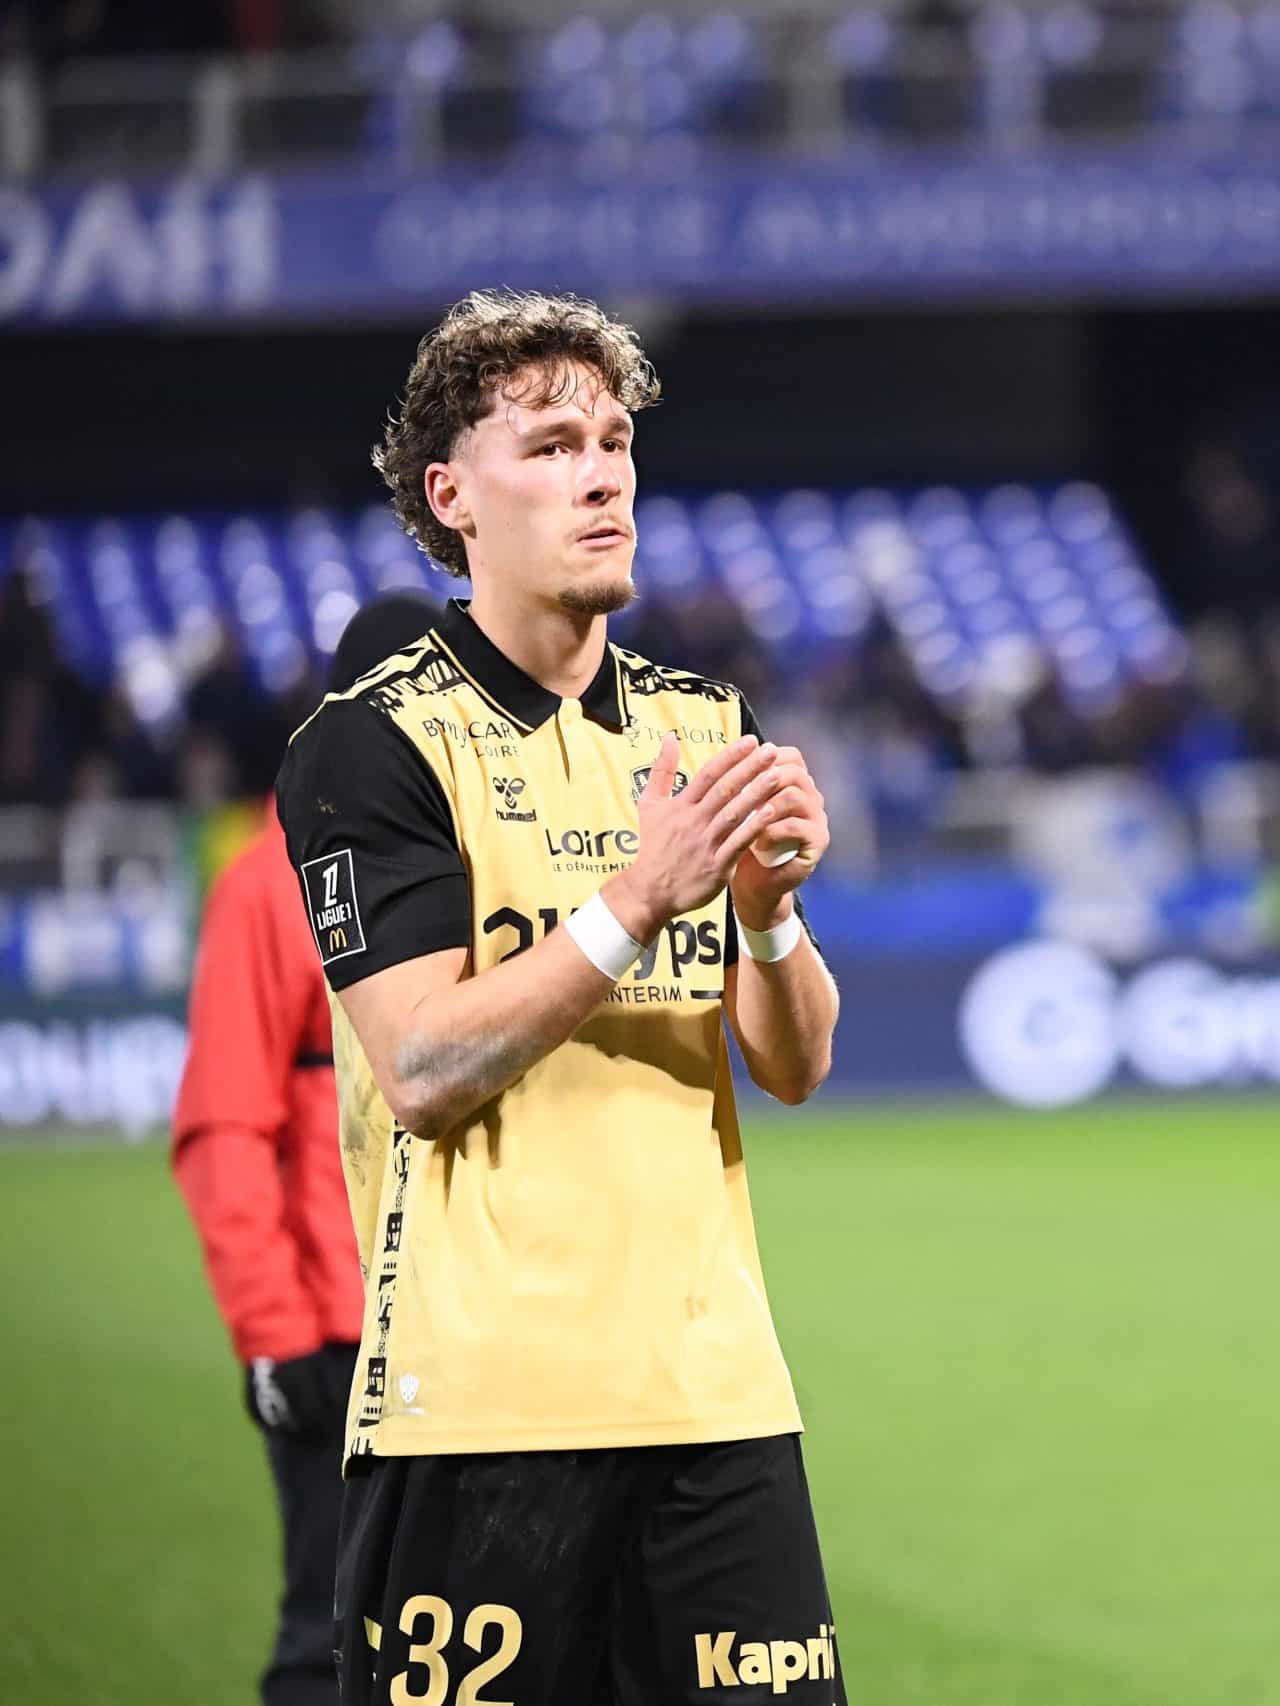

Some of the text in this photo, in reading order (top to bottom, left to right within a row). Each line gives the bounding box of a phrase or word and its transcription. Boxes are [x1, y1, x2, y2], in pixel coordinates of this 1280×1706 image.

[495, 808, 537, 823] hummel
[545, 828, 639, 857] Loire
[605, 985, 682, 1003] NTERIM
[390, 1594, 522, 1706] 32
[695, 1623, 836, 1694] Kapri
